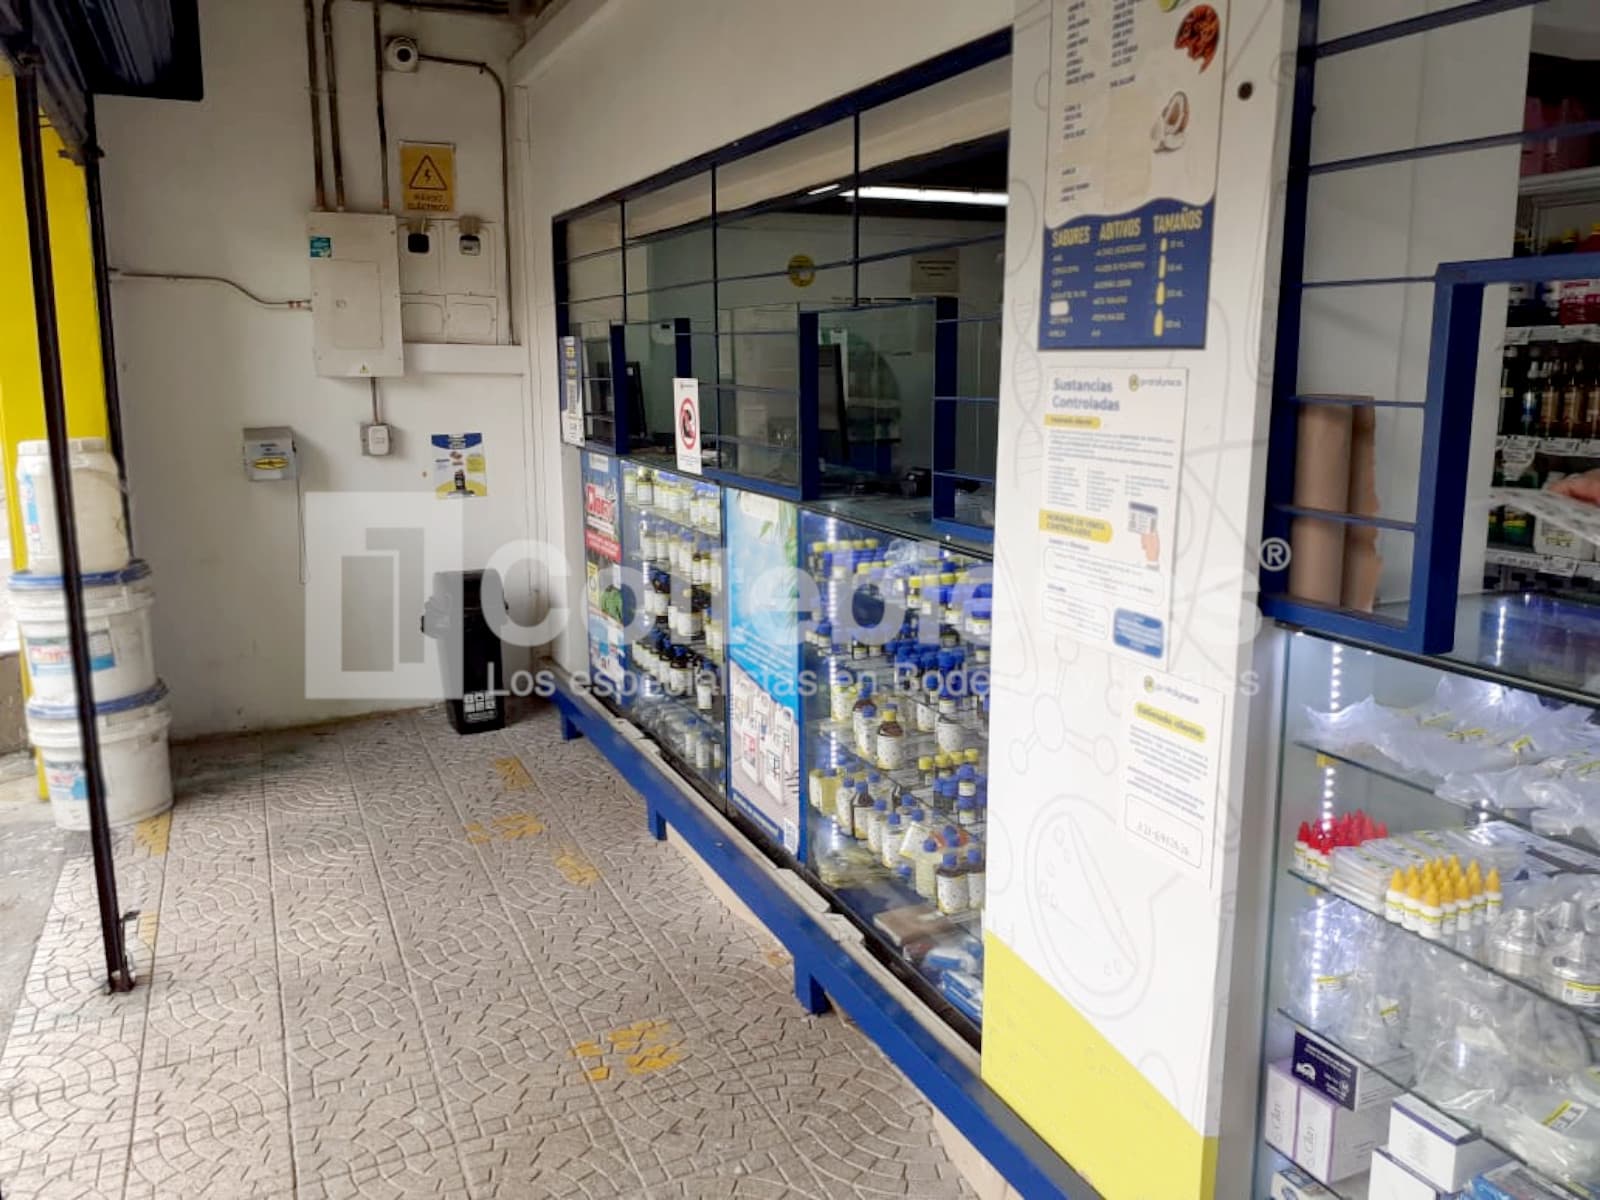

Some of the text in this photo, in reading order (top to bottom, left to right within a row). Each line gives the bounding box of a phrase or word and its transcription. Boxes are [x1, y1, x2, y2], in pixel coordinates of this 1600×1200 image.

[1100, 217, 1142, 241] ADITIVOS
[1153, 206, 1203, 234] TAMAÑOS
[1052, 225, 1091, 248] SABORES
[1053, 377, 1112, 393] Sustancias
[1052, 395, 1120, 412] Controladas
